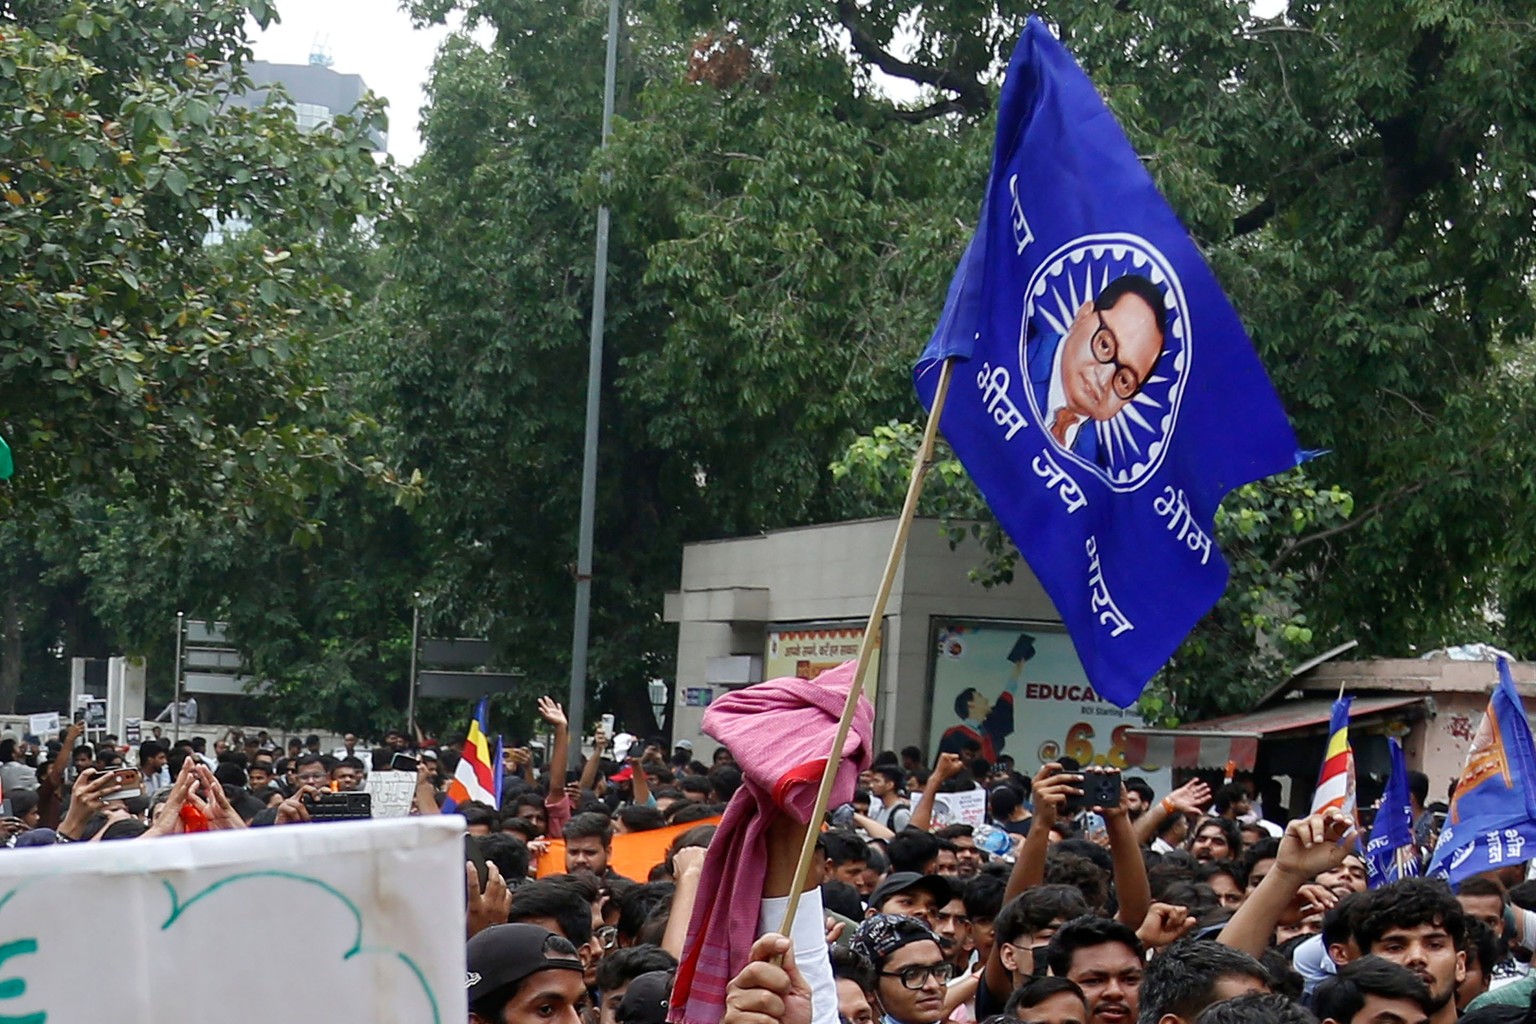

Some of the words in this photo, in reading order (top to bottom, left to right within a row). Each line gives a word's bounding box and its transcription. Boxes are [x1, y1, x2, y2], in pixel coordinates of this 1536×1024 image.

[977, 362, 1028, 440] भीम
[1032, 448, 1088, 513] जय
[1085, 535, 1135, 637] भारत
[1026, 683, 1104, 702] EDUCA
